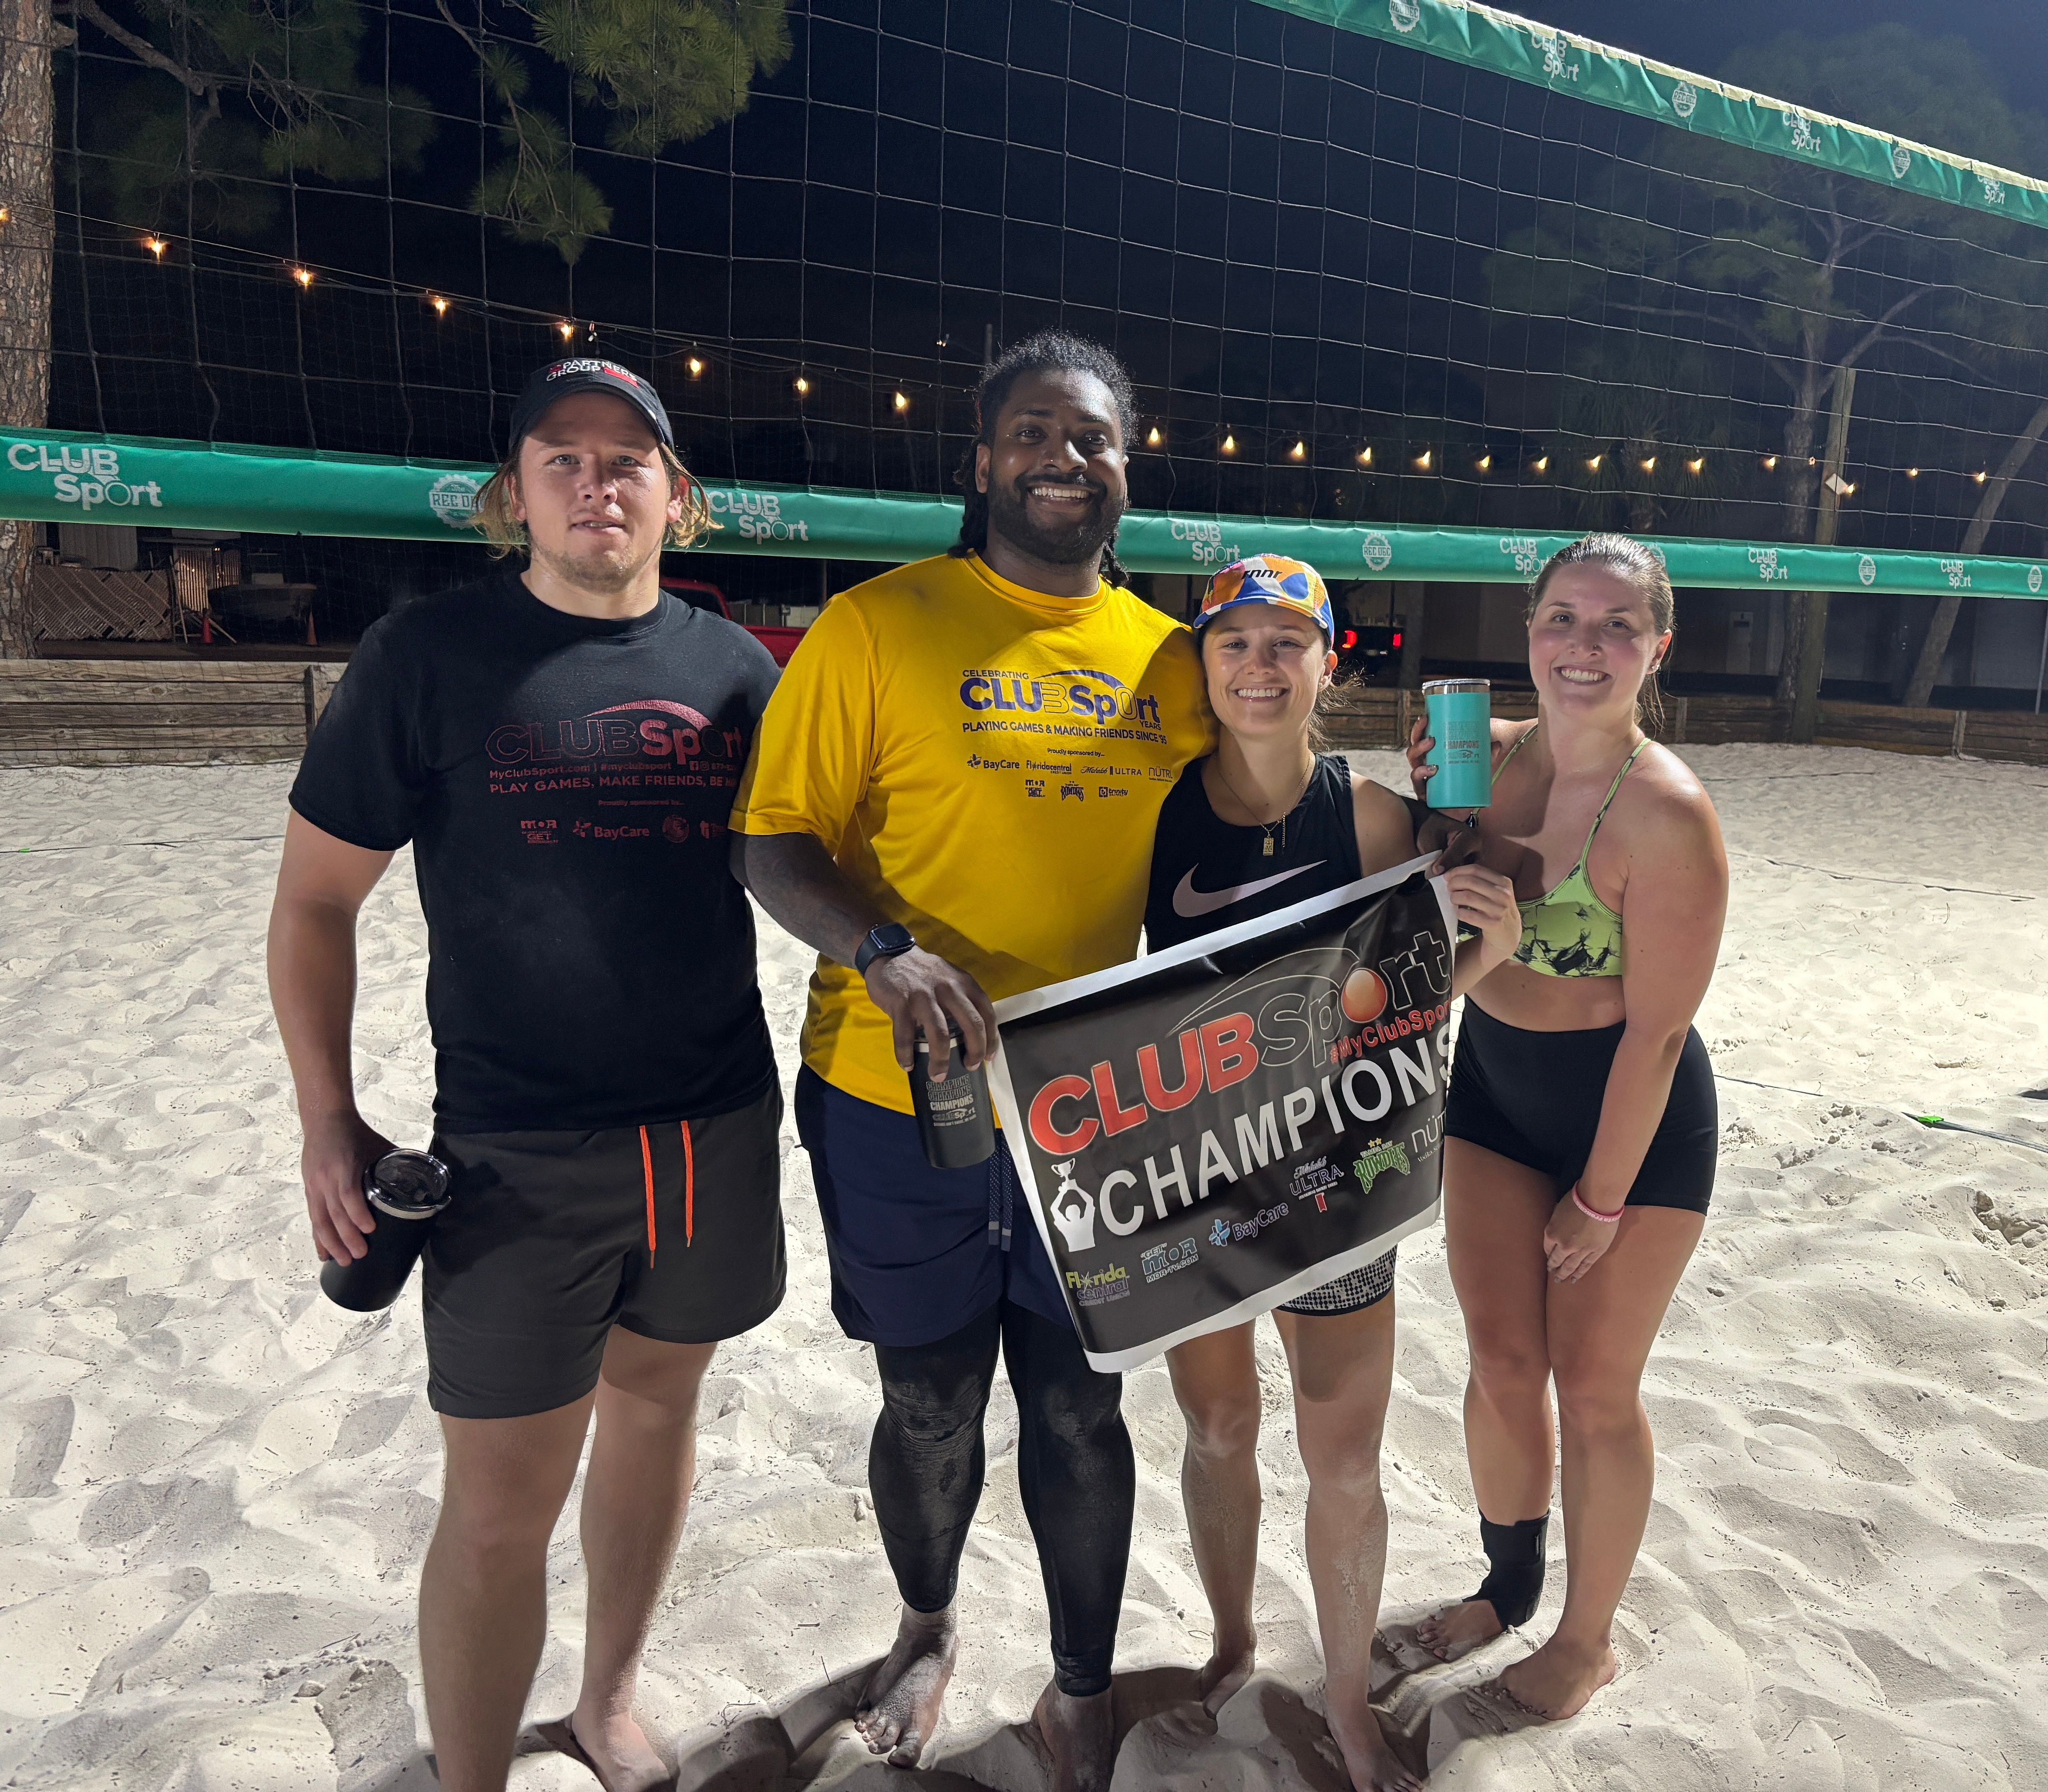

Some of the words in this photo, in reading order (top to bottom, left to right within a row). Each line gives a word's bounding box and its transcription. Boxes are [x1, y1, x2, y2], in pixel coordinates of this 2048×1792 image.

[1543, 53, 1579, 82] Sport
[1792, 128, 1821, 152] Sport
[546, 366, 601, 381] GROUP
[563, 360, 638, 381] PARTNERS
[8, 444, 119, 476] CLUB
[54, 474, 162, 511] Sport
[708, 491, 780, 516] CLUB
[738, 515, 809, 545] Sport
[1171, 522, 1222, 542] CLUB
[1192, 541, 1240, 566] Sport
[1499, 538, 1537, 554] CLUB
[1515, 554, 1546, 575] Spor
[1748, 549, 1777, 564] CLUB
[1941, 559, 1963, 573] CLUB
[1760, 563, 1788, 582] Sport
[1949, 573, 1971, 589] Sport
[962, 670, 1029, 680] CELEBRATING
[962, 721, 1008, 732] PLAYING
[1009, 721, 1044, 733] GAMES
[1046, 724, 1052, 734] &
[1053, 724, 1092, 737] MAKING
[1094, 727, 1134, 739] FRIENDS
[1136, 732, 1159, 742] SINCE
[1159, 735, 1167, 745] '95
[1139, 720, 1161, 730] YEARS
[983, 760, 1020, 771] BayCare
[490, 782, 528, 794] PLAY
[534, 777, 595, 791] GAMES,
[600, 776, 641, 786] MAKE
[645, 776, 706, 787] FRIENDS,
[710, 776, 723, 786] BE
[594, 826, 650, 841] BayCare
[930, 1093, 974, 1111] CHAMPIONS
[1289, 1164, 1344, 1196] ULTRA
[1232, 1202, 1289, 1241] BayCare
[1146, 1254, 1199, 1283] MOR-TV.COM
